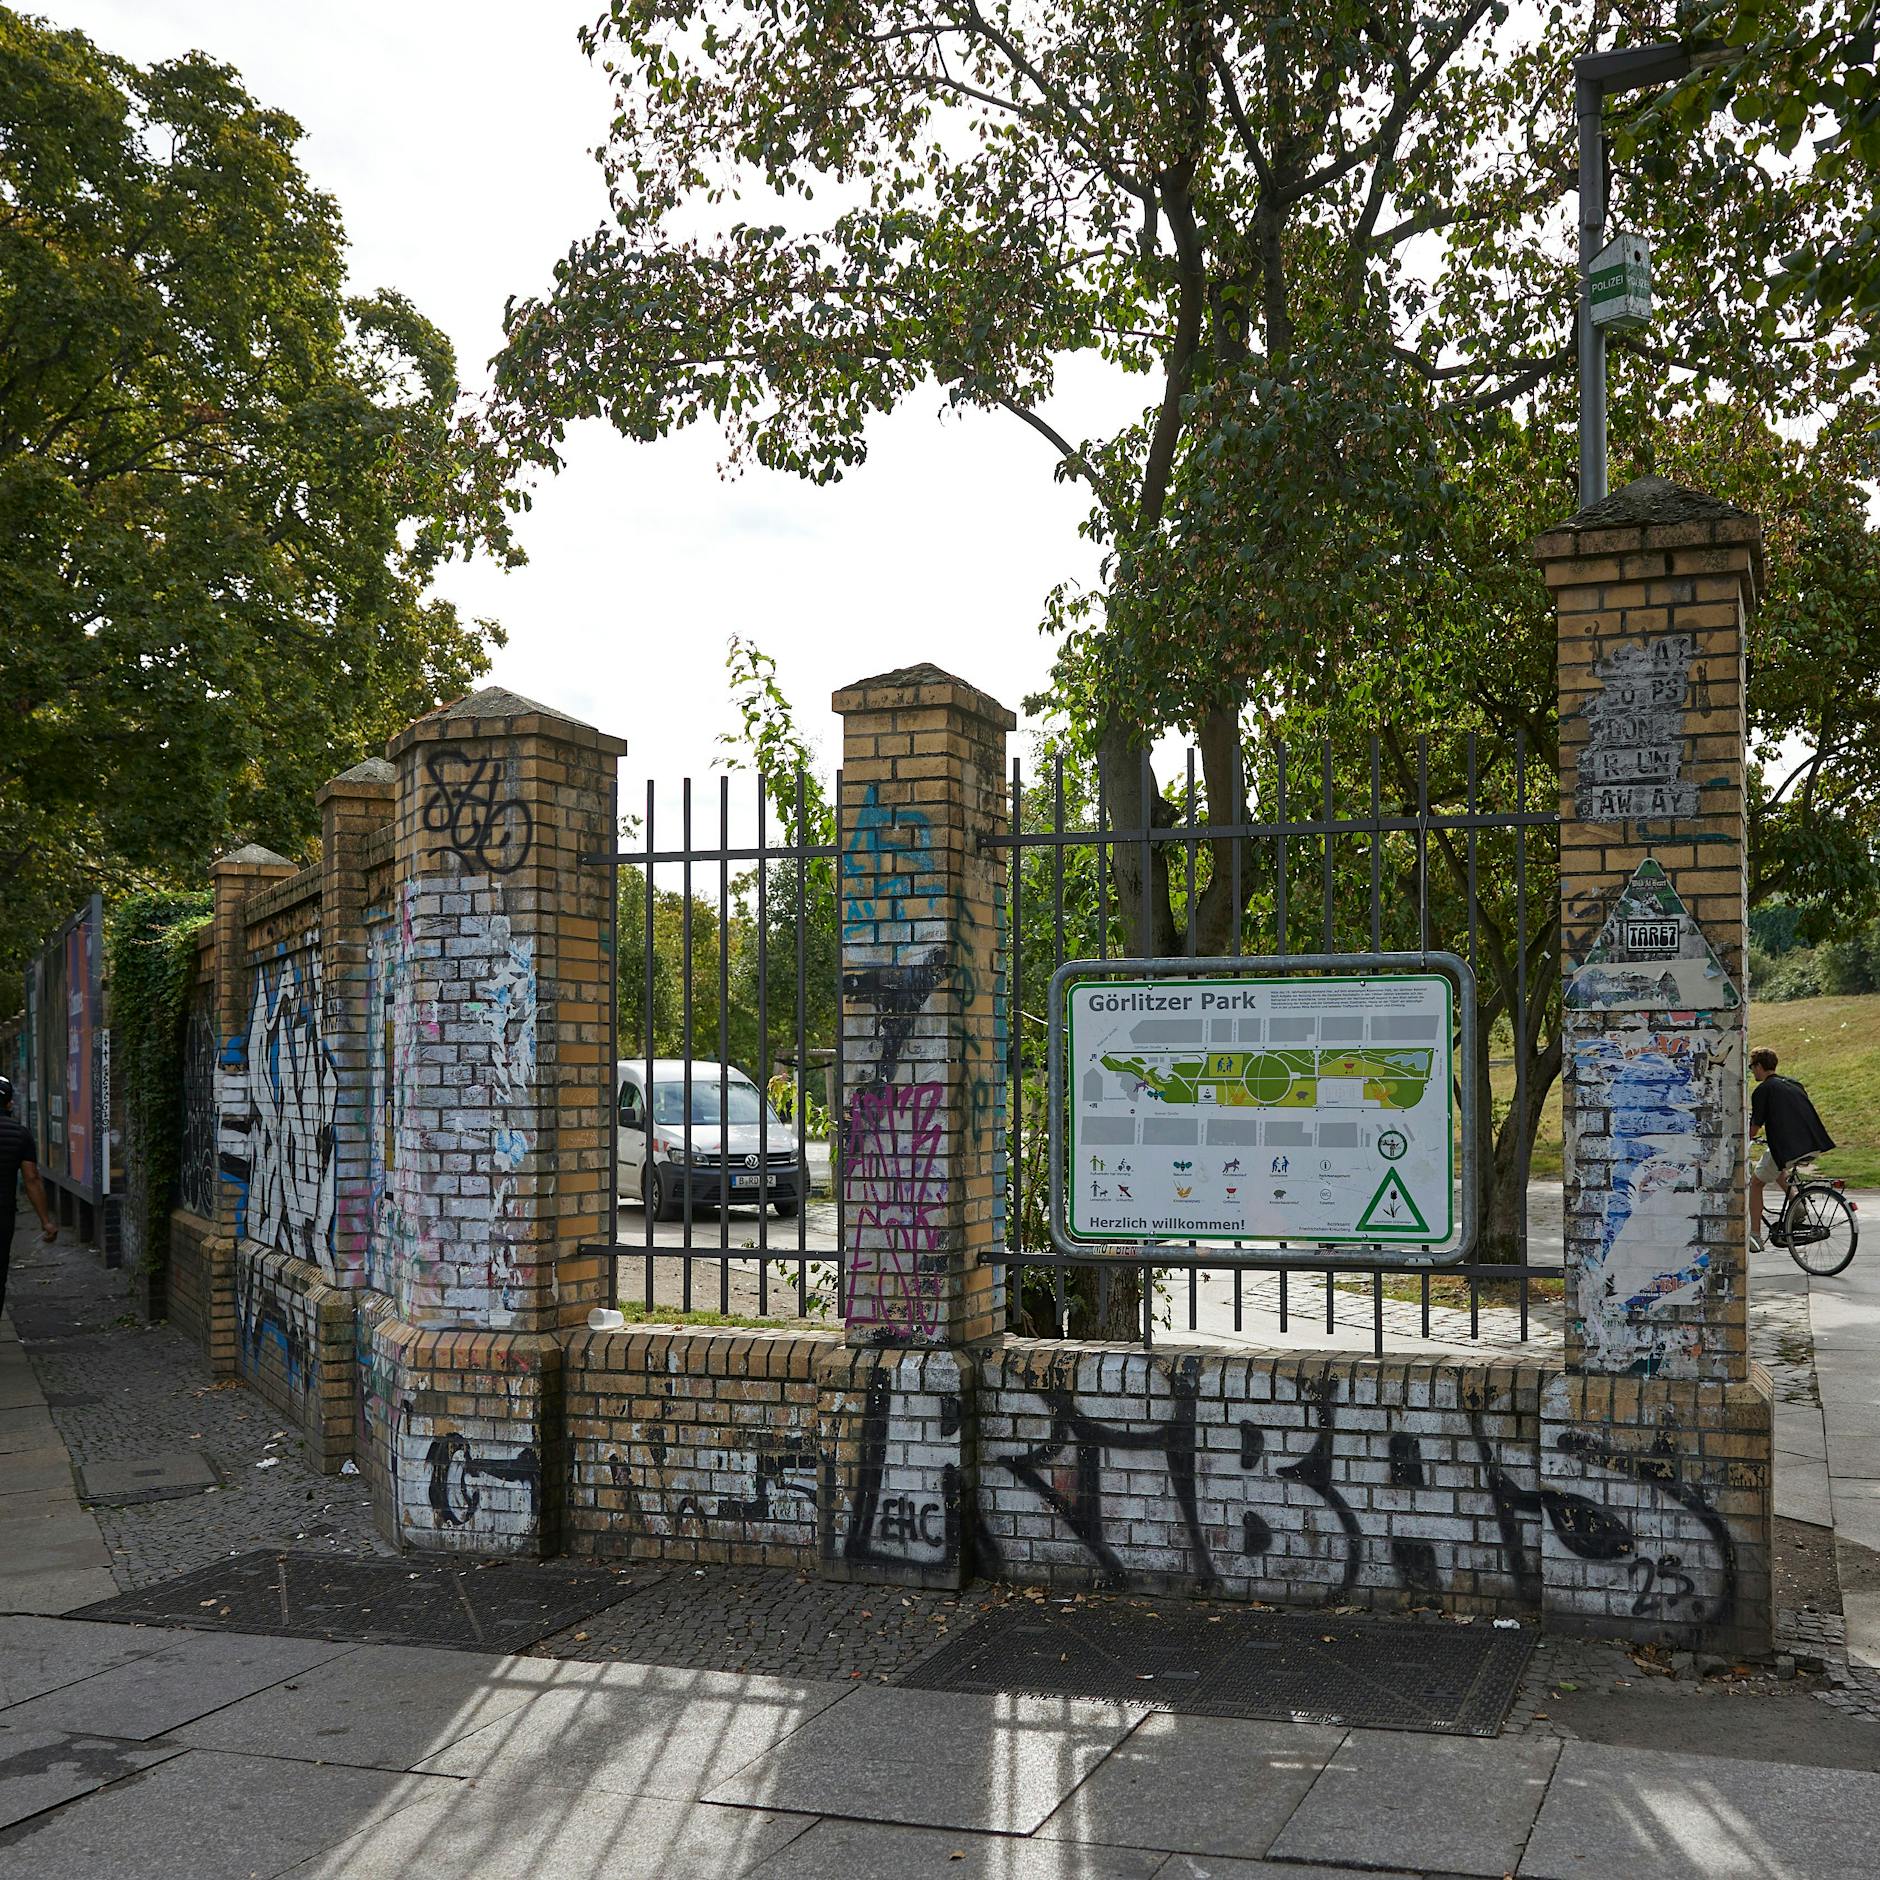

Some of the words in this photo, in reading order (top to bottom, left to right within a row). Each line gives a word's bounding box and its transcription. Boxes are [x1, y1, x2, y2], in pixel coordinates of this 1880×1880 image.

[1592, 275, 1624, 293] POLIZEI
[1599, 787, 1683, 814] AWAY
[1089, 993, 1192, 1012] Görlitzer
[1201, 991, 1256, 1010] Park
[1090, 1217, 1147, 1229] Herzlich
[1152, 1217, 1245, 1231] willkommen!
